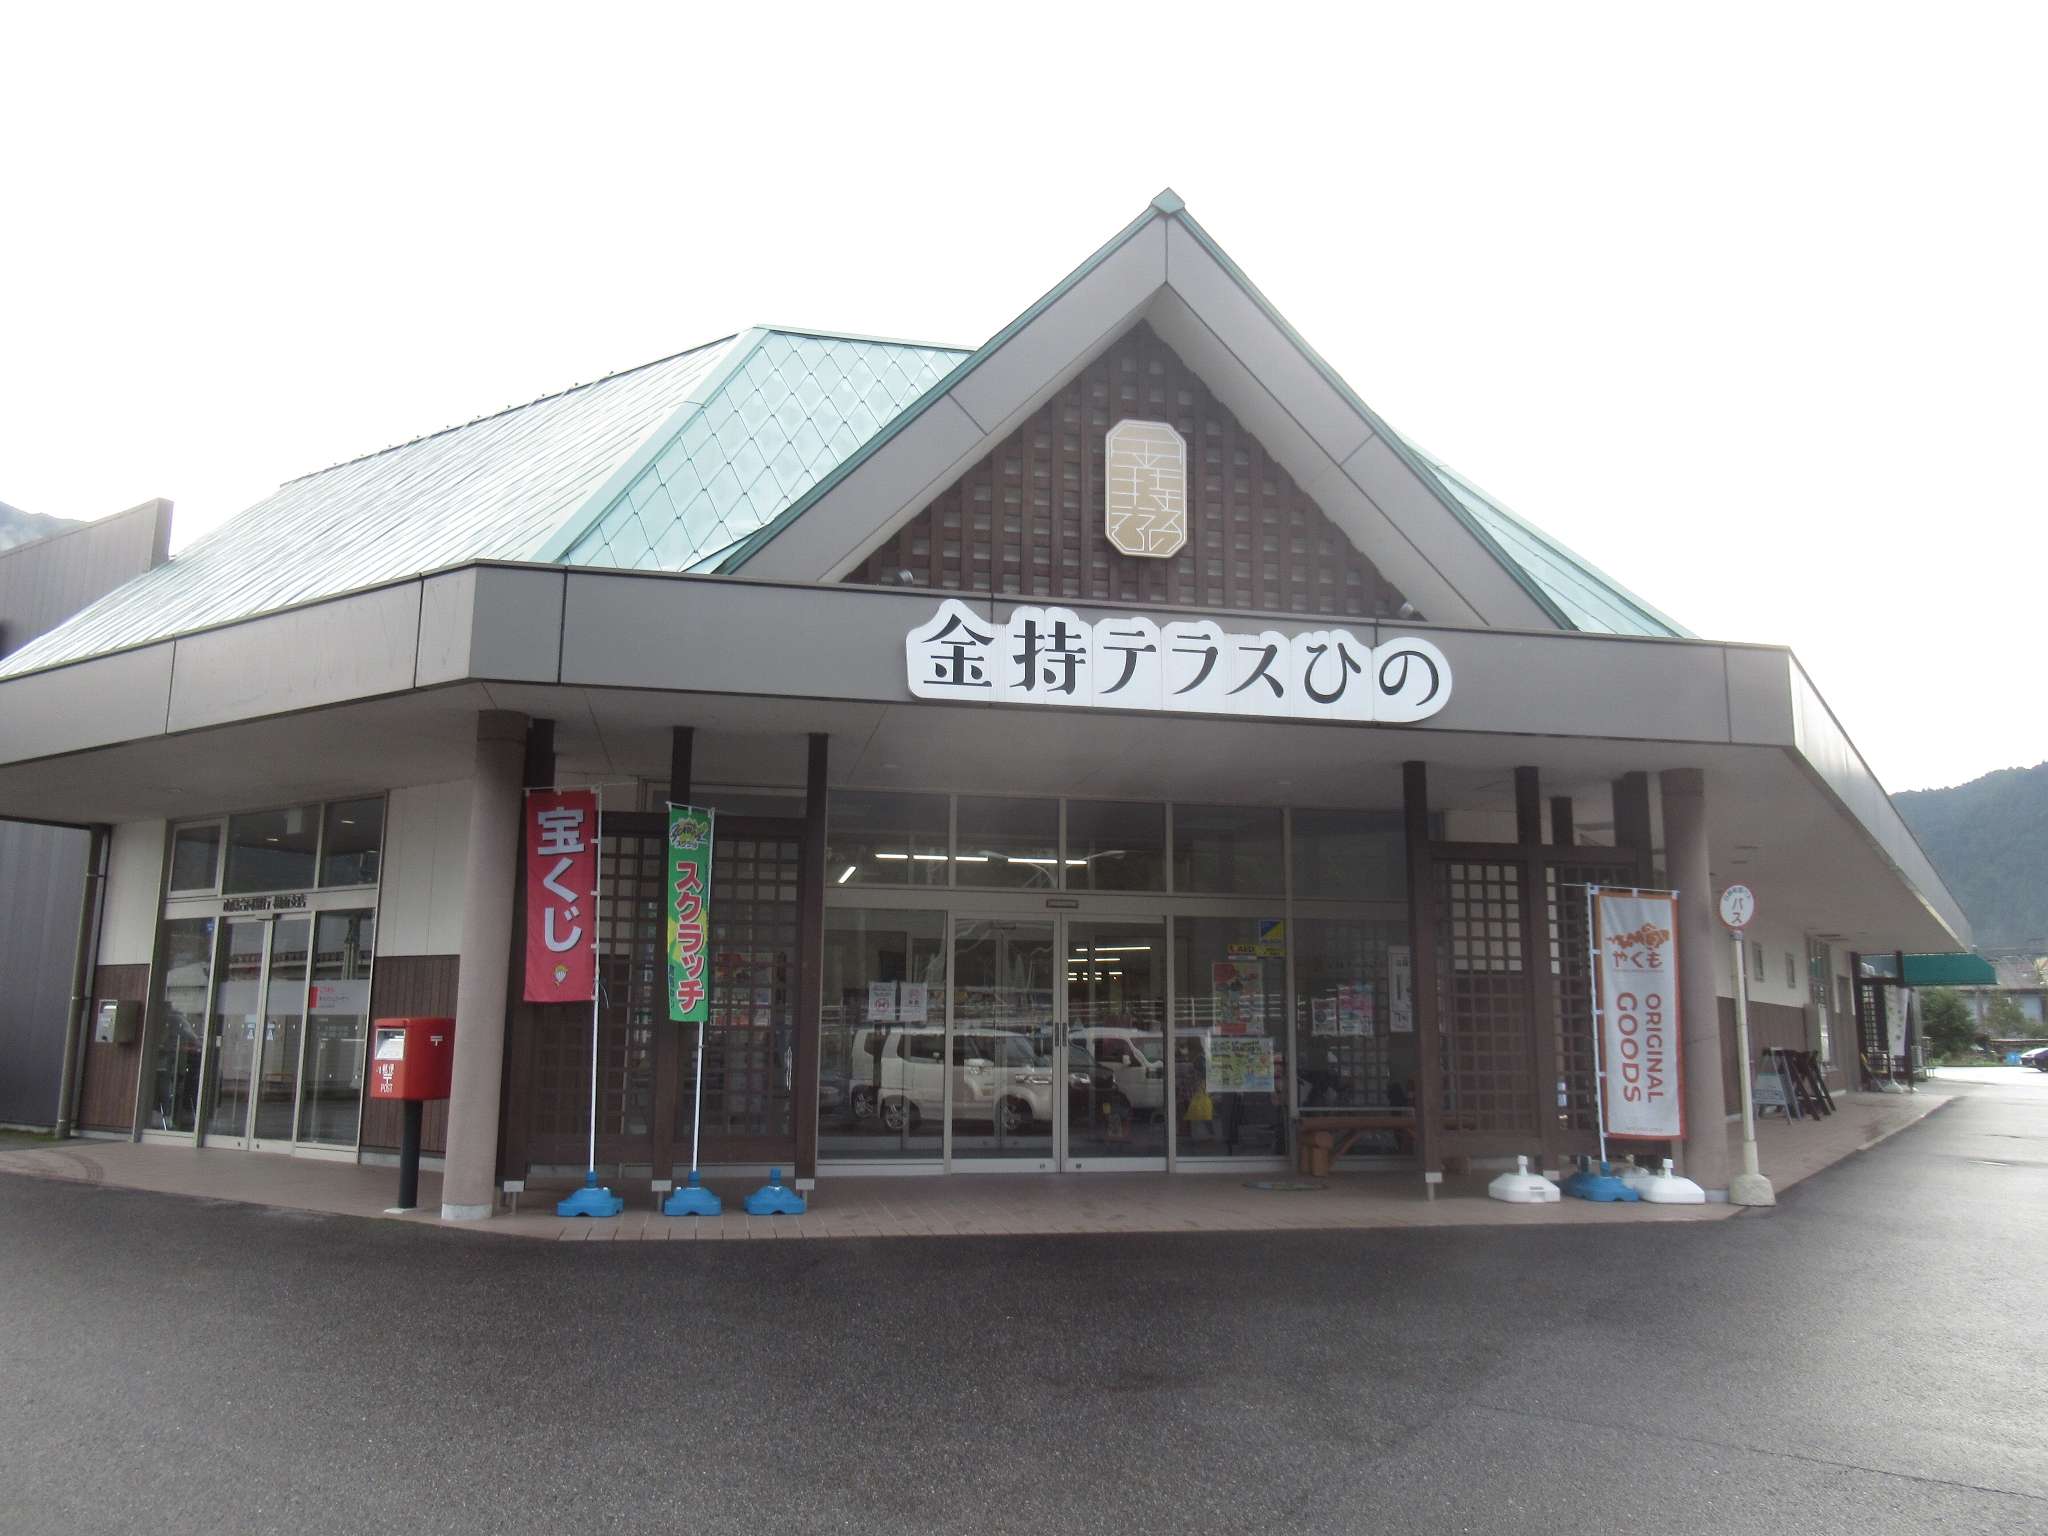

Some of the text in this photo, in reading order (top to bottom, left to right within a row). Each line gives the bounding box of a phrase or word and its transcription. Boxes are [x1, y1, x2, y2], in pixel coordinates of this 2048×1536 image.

[921, 613, 1440, 706] 金持テラスひの
[538, 806, 585, 952] 宝くじ
[1732, 897, 1744, 924] バス
[675, 862, 704, 1014] スクラッチ
[1612, 947, 1663, 968] やくも
[1616, 992, 1641, 1102] GOODS
[1645, 993, 1664, 1103] ORIGINAL
